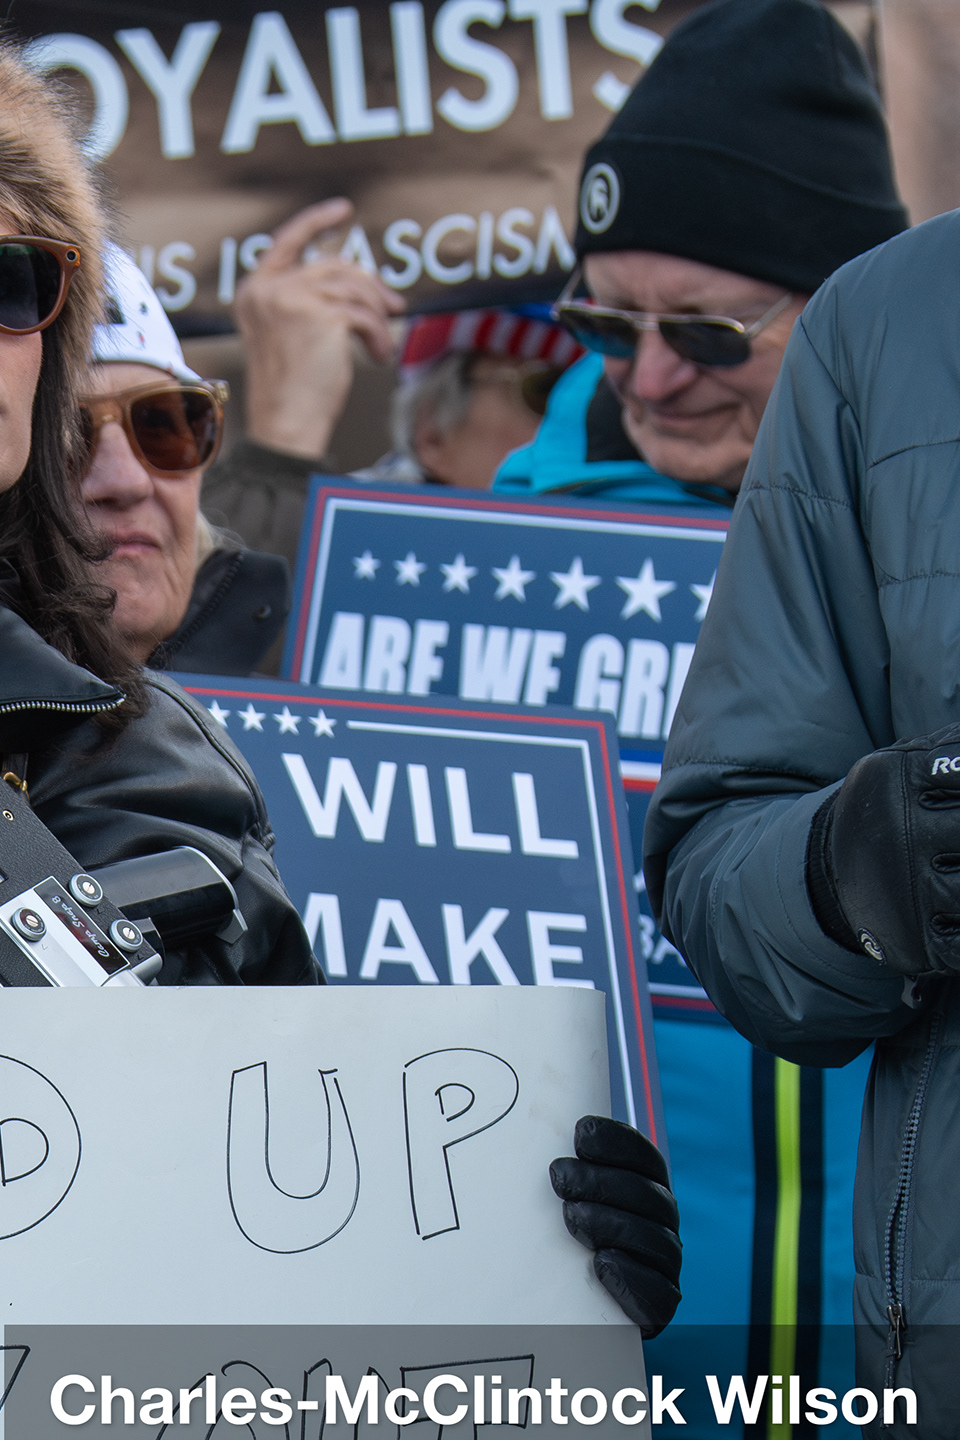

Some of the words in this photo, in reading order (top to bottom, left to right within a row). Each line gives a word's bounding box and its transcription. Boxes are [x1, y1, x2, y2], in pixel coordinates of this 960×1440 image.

[303, 205, 576, 289] ASCISM
[282, 753, 579, 859] WILL
[227, 1047, 519, 1254] UP
